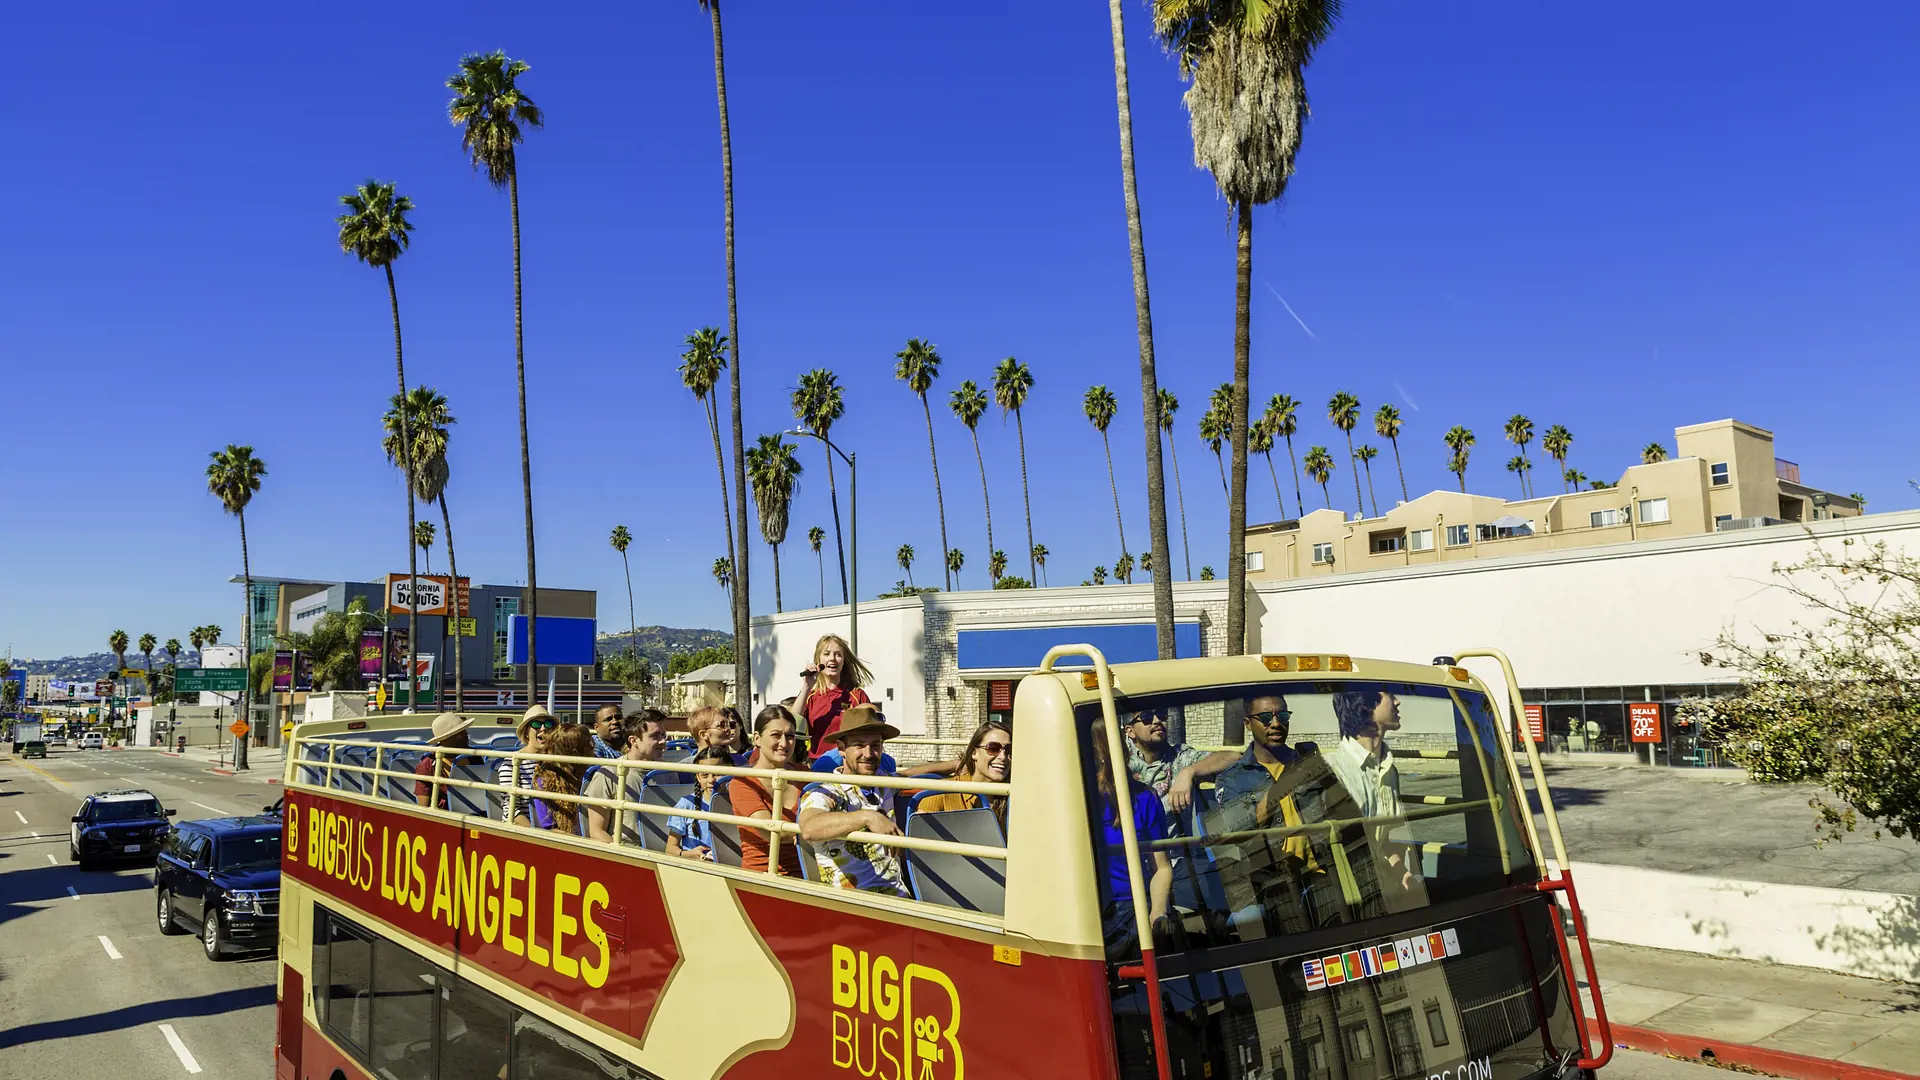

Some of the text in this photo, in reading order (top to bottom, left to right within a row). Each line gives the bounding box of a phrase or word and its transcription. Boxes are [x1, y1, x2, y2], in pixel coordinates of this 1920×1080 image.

[1632, 718, 1654, 728] 70%
[1634, 728, 1654, 736] OFF
[380, 826, 427, 913] LOS
[431, 841, 610, 989] ANGELES
[832, 943, 900, 1021] BIG
[832, 1010, 901, 1080] BUS
